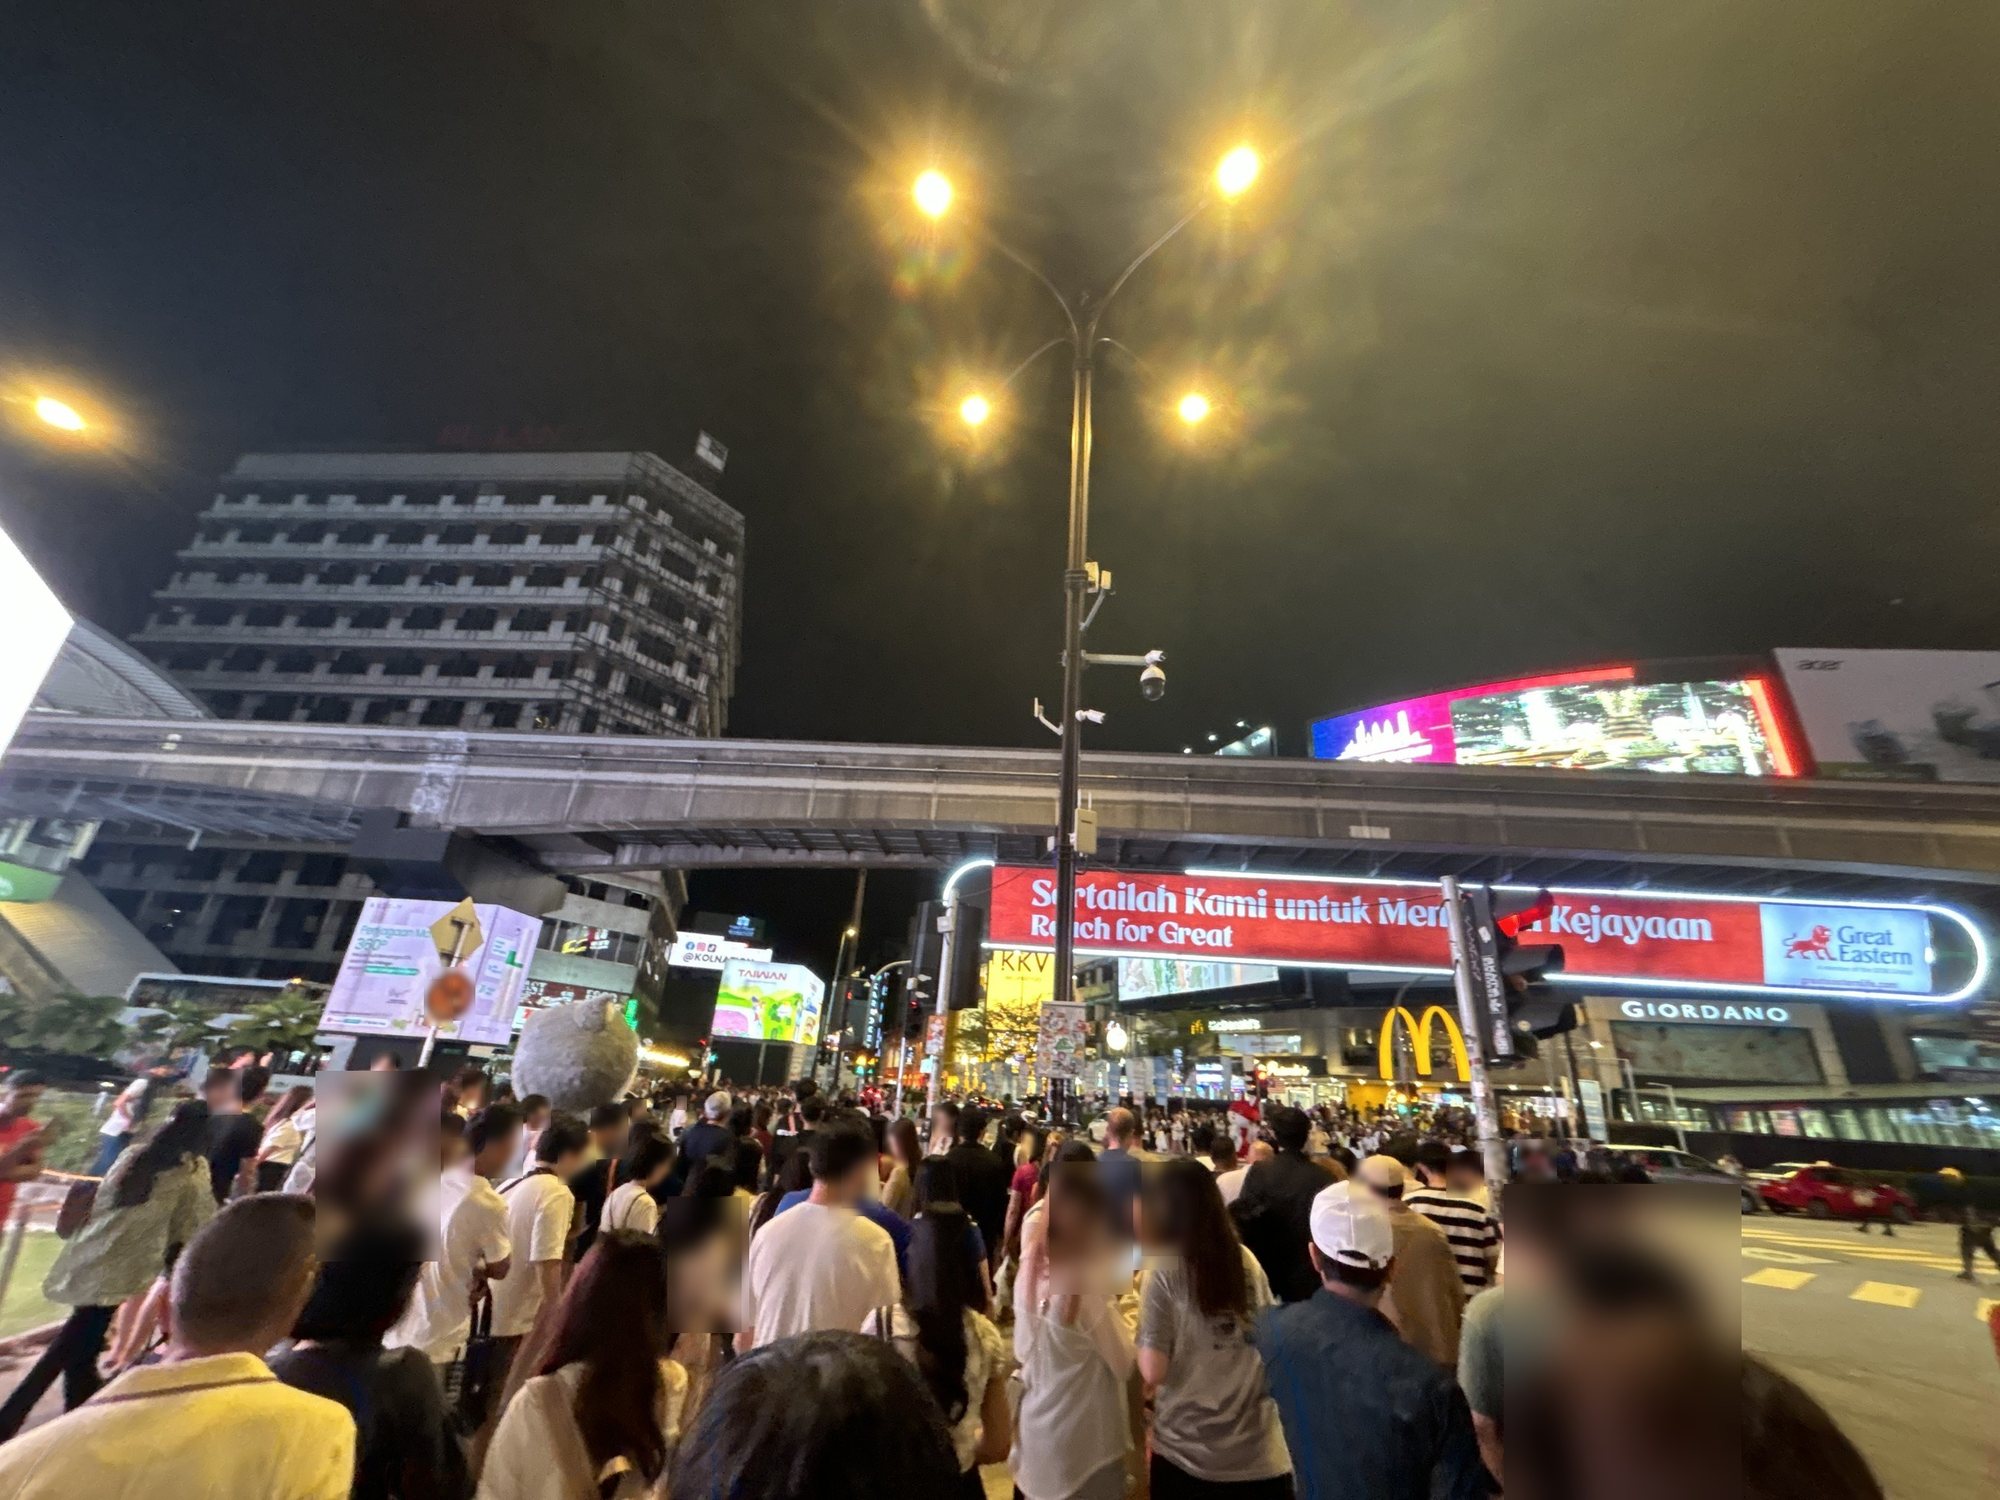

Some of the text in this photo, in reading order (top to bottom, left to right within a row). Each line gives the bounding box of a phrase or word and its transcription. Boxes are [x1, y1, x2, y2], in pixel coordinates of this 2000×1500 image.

[1184, 887, 1267, 918] Kami
[1275, 895, 1372, 925] untuk
[1550, 905, 1713, 944] Kejayaan
[1116, 918, 1154, 943] for
[1158, 921, 1233, 947] Great
[1837, 925, 1894, 946] Great
[1001, 951, 1049, 973] KKV
[1839, 945, 1913, 965] Eastern
[738, 969, 788, 981] TAIWAN
[1621, 1000, 1790, 1023] GIORDANO
